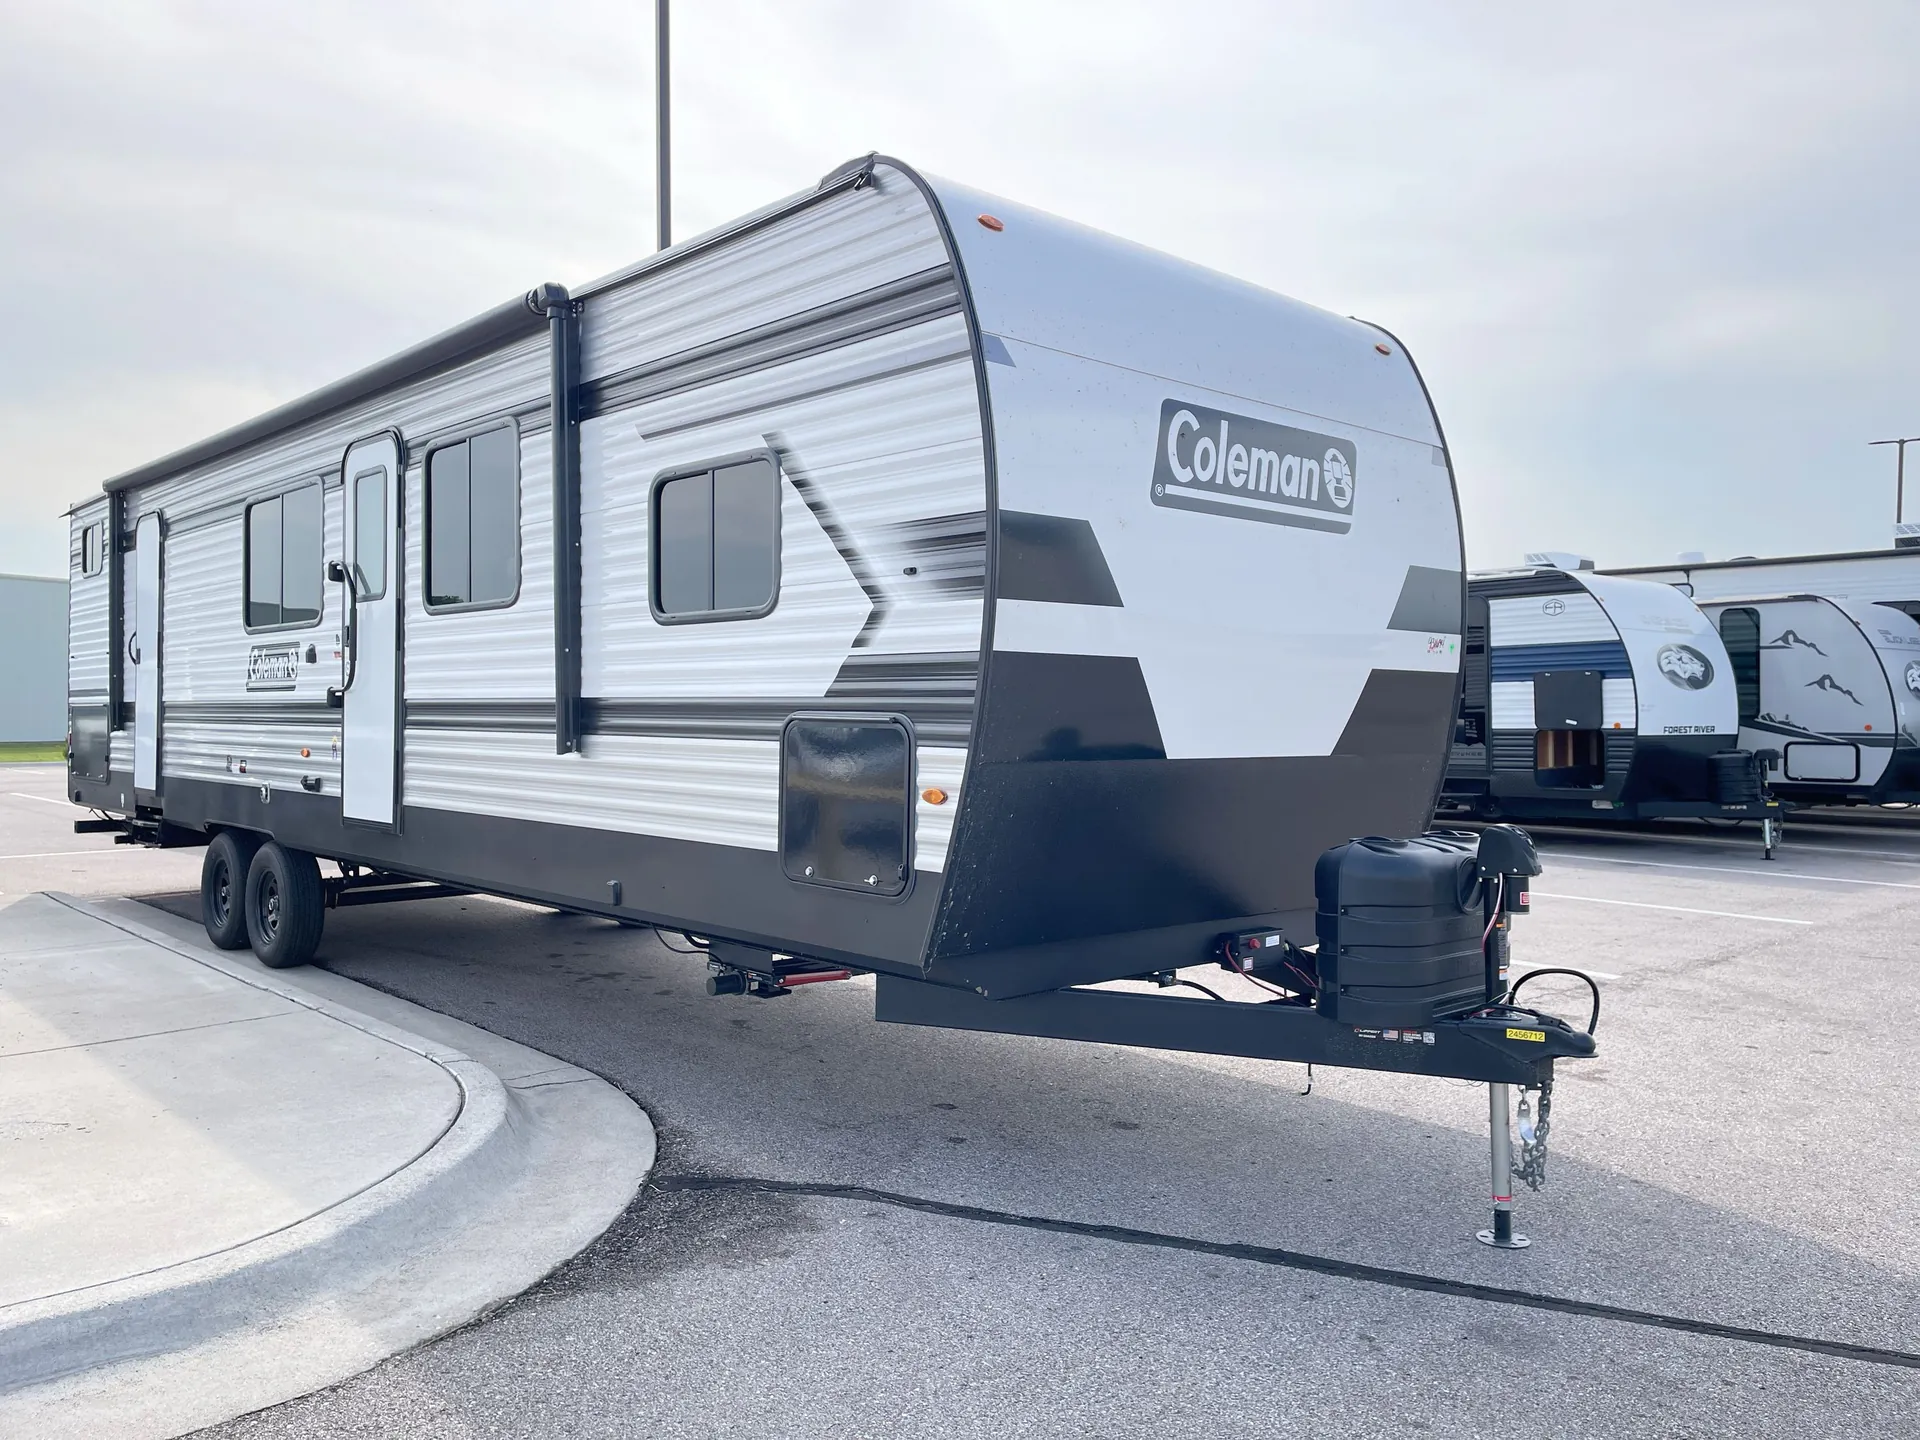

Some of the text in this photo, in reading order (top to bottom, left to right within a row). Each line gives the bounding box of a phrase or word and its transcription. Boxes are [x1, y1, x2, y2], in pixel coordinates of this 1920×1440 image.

[1167, 409, 1320, 501] Coleman
[250, 648, 289, 681] Coleman
[1663, 725, 1716, 734] FOREST RIVER
[1508, 1029, 1544, 1041] 2456712
